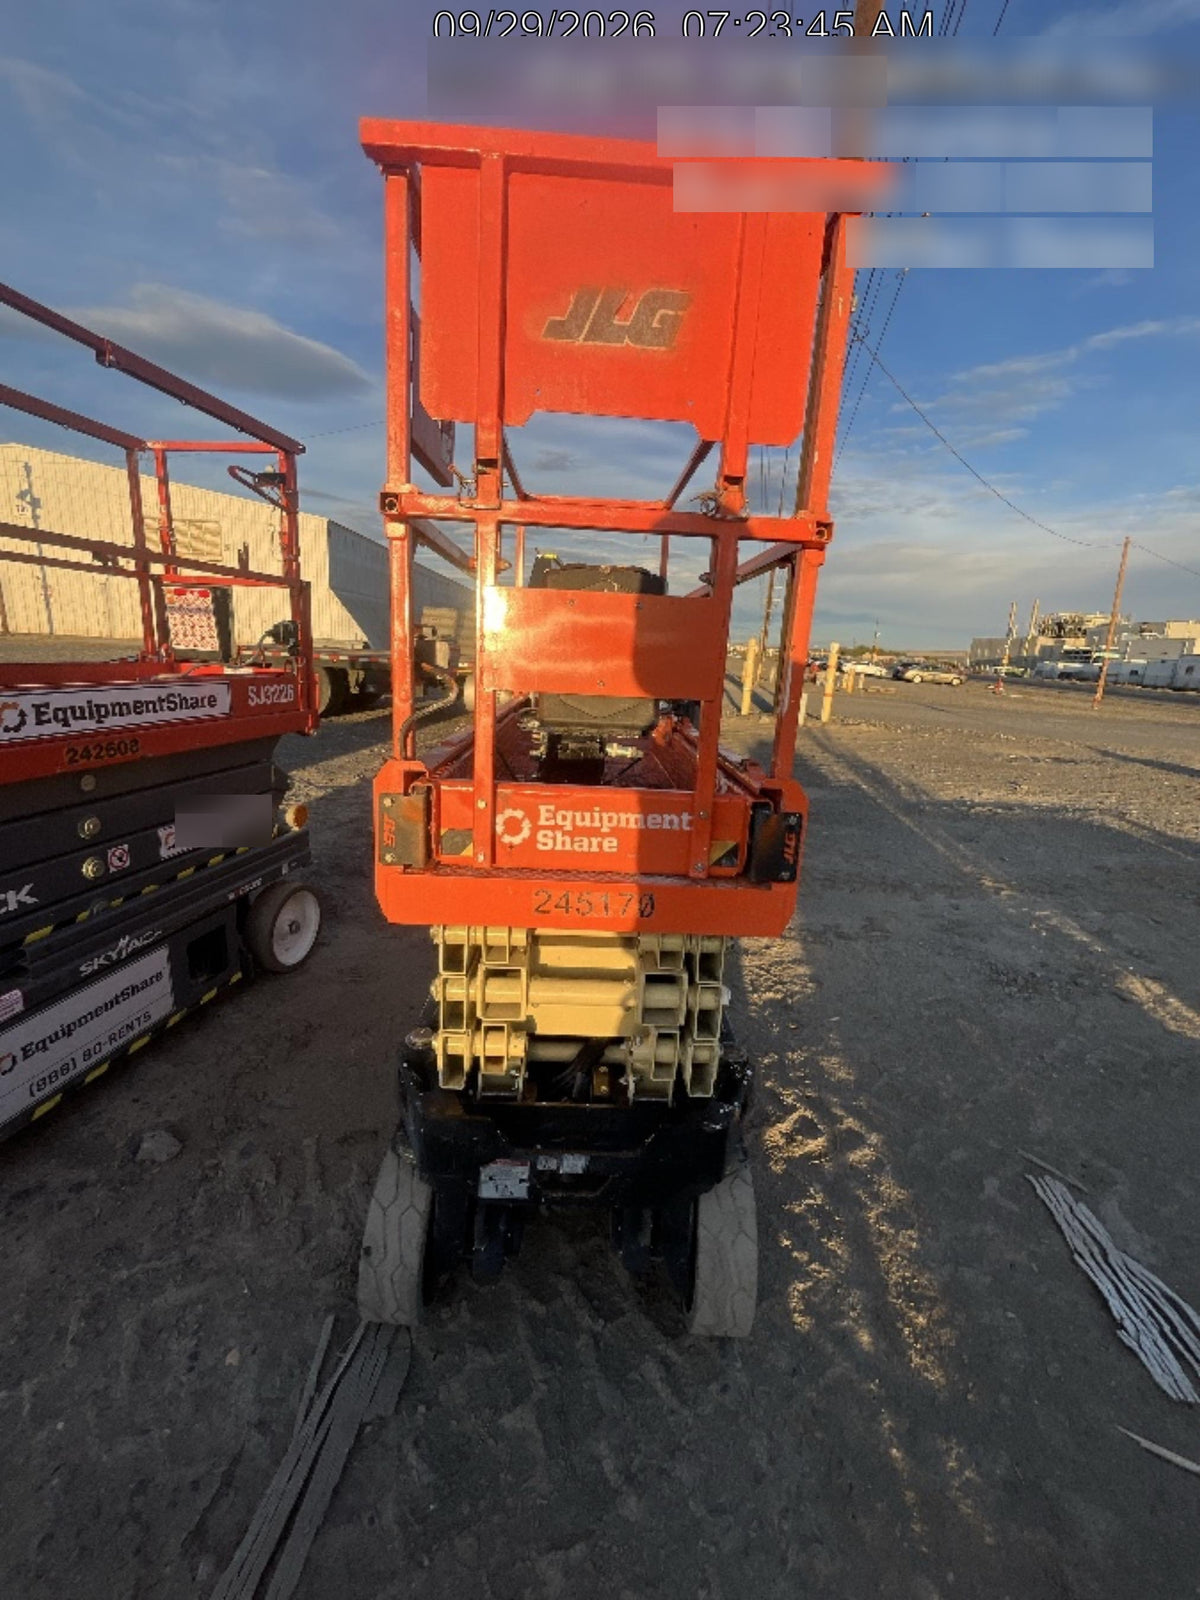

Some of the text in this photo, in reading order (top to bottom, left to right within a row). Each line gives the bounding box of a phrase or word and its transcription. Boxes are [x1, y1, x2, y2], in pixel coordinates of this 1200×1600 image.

[540, 286, 694, 350] JLG
[32, 693, 218, 727] EquipmentShare
[248, 684, 294, 706] SJ3226
[537, 804, 693, 833] Equipment
[536, 829, 618, 853] Share
[533, 888, 655, 919] 245170
[20, 969, 163, 1061] EquipmentShare
